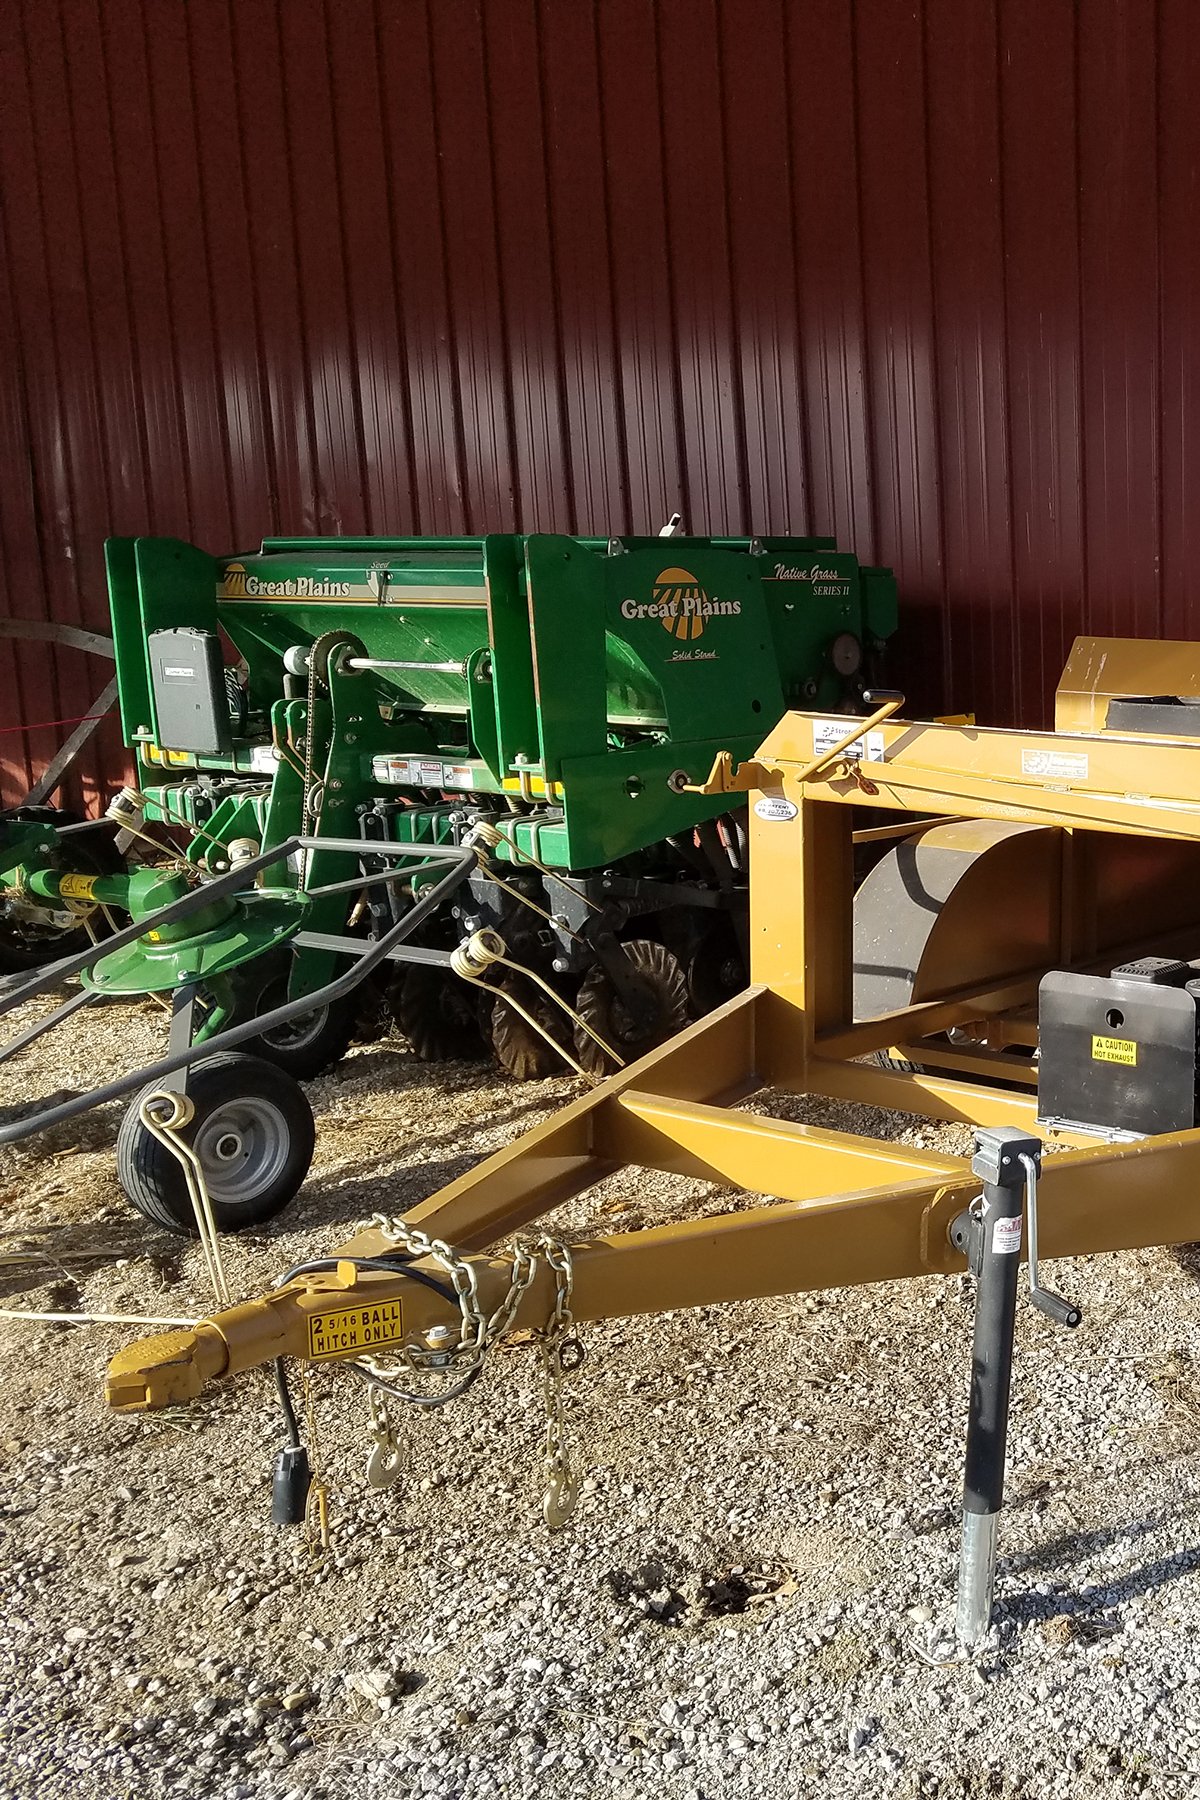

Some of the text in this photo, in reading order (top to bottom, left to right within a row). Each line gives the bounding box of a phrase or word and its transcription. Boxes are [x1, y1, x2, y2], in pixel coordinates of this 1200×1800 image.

[774, 563, 838, 584] Native Grass
[245, 577, 350, 597] Great Plains
[813, 586, 850, 596] SERIES II
[621, 597, 741, 619] Great Plains
[672, 649, 716, 660] Solid Stand
[1094, 1050, 1134, 1062] HOT EXHAUST
[1105, 1040, 1133, 1052] CAUTION
[313, 1306, 398, 1334] 2 5/16 BALL
[317, 1322, 396, 1352] HITCH ONLY
